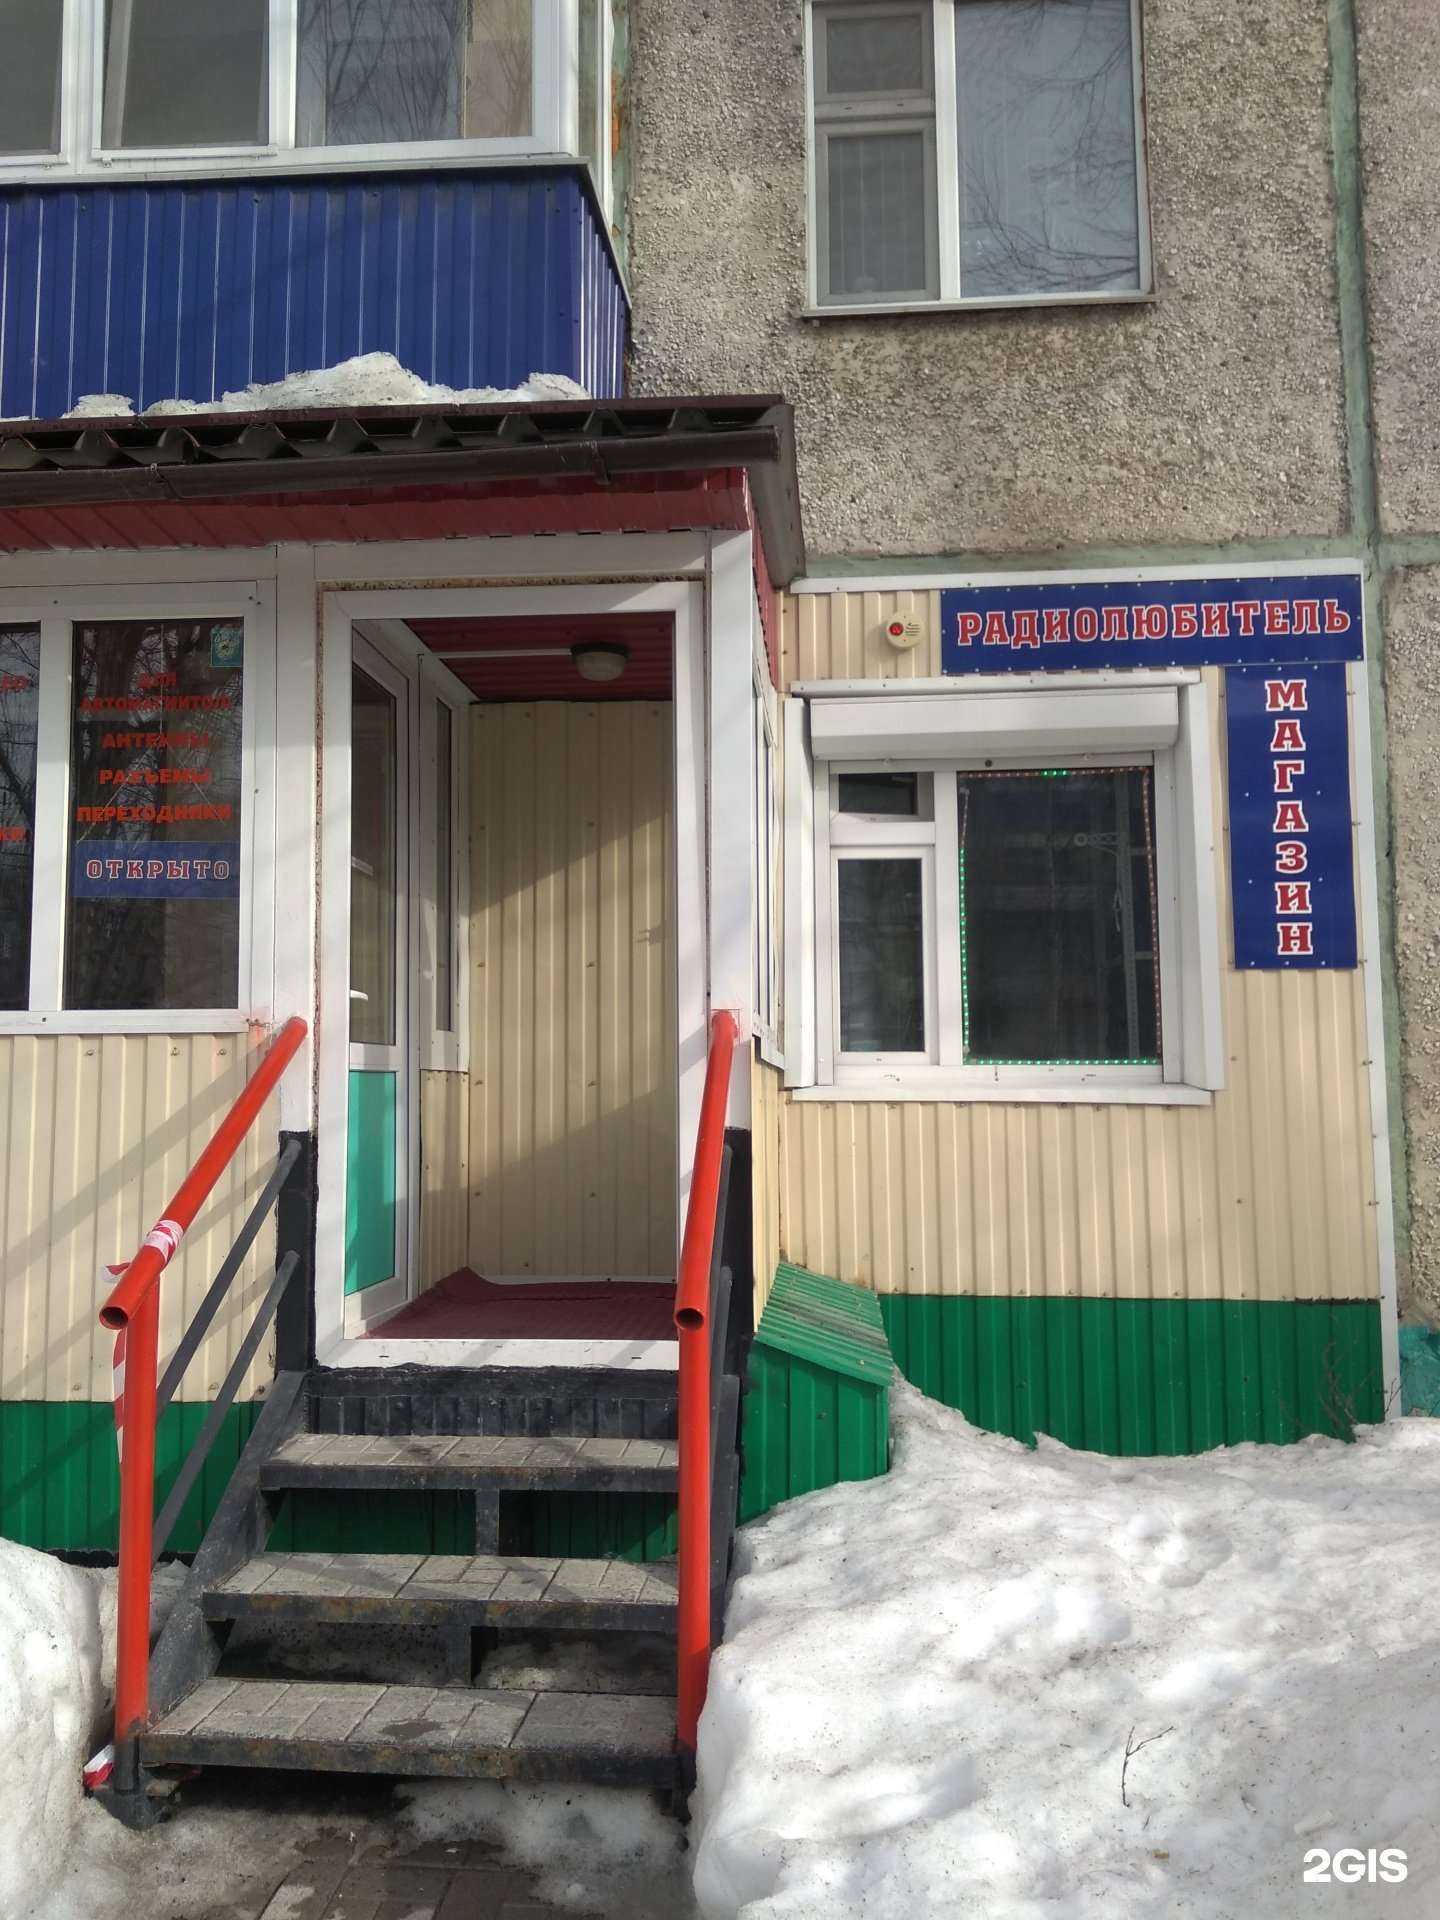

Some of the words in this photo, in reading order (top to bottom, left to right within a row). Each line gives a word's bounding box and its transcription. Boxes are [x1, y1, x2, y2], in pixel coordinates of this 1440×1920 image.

[957, 599, 1351, 650] РАДИОЛЮБИТЕЛЬ
[99, 767, 211, 785] РАЗЪЕМЫ
[76, 804, 232, 823] ПЕРЕХОДНИКИ
[1264, 679, 1315, 956] МАГАЗИН
[86, 859, 230, 880] ОТКРЫТО
